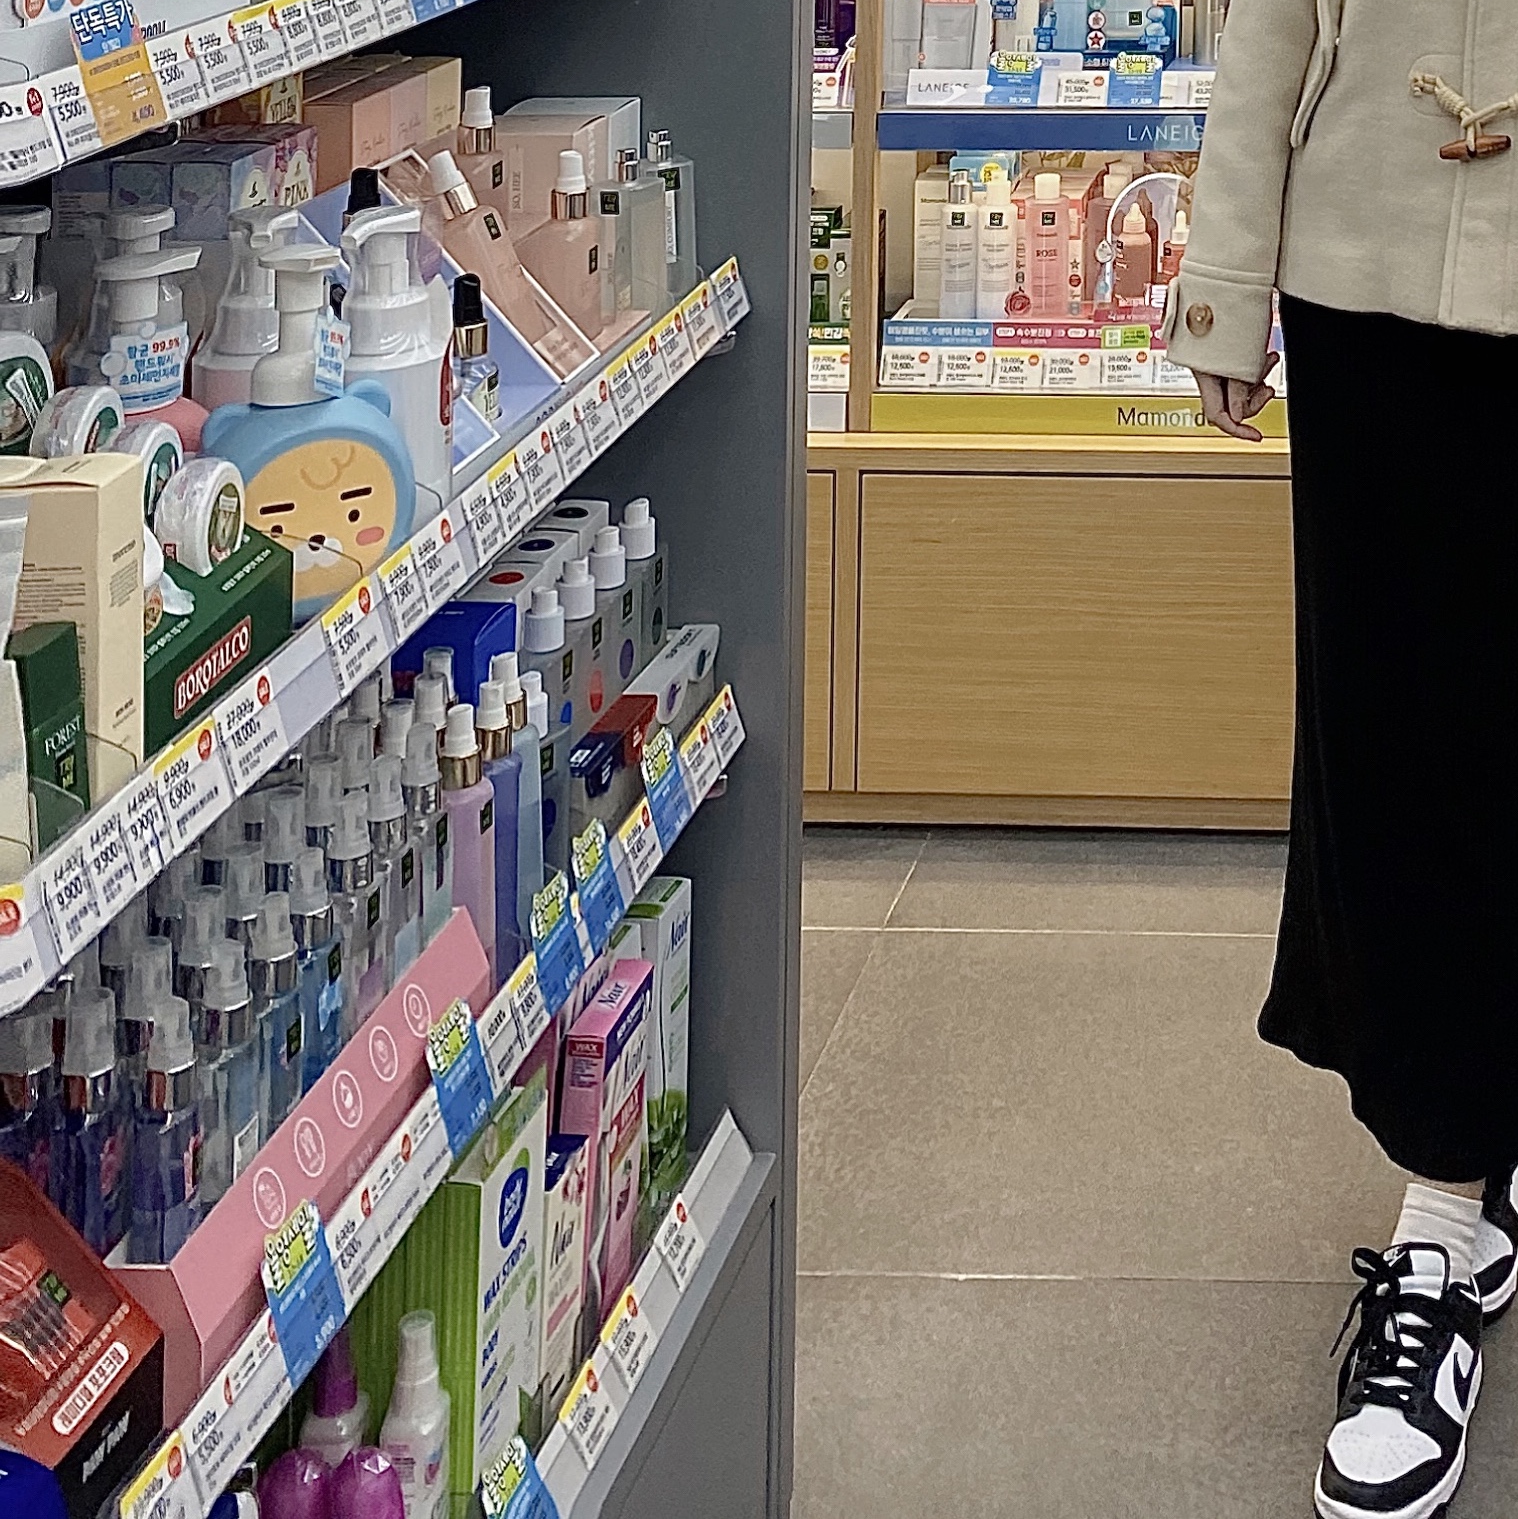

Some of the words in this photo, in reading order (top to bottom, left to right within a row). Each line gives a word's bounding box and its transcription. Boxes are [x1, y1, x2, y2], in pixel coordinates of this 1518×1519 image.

[1035, 249, 1058, 258] ROSE
[1117, 406, 1209, 427] Mamond
[176, 623, 250, 712] BOROTALCO
[576, 1041, 598, 1053] WAX
